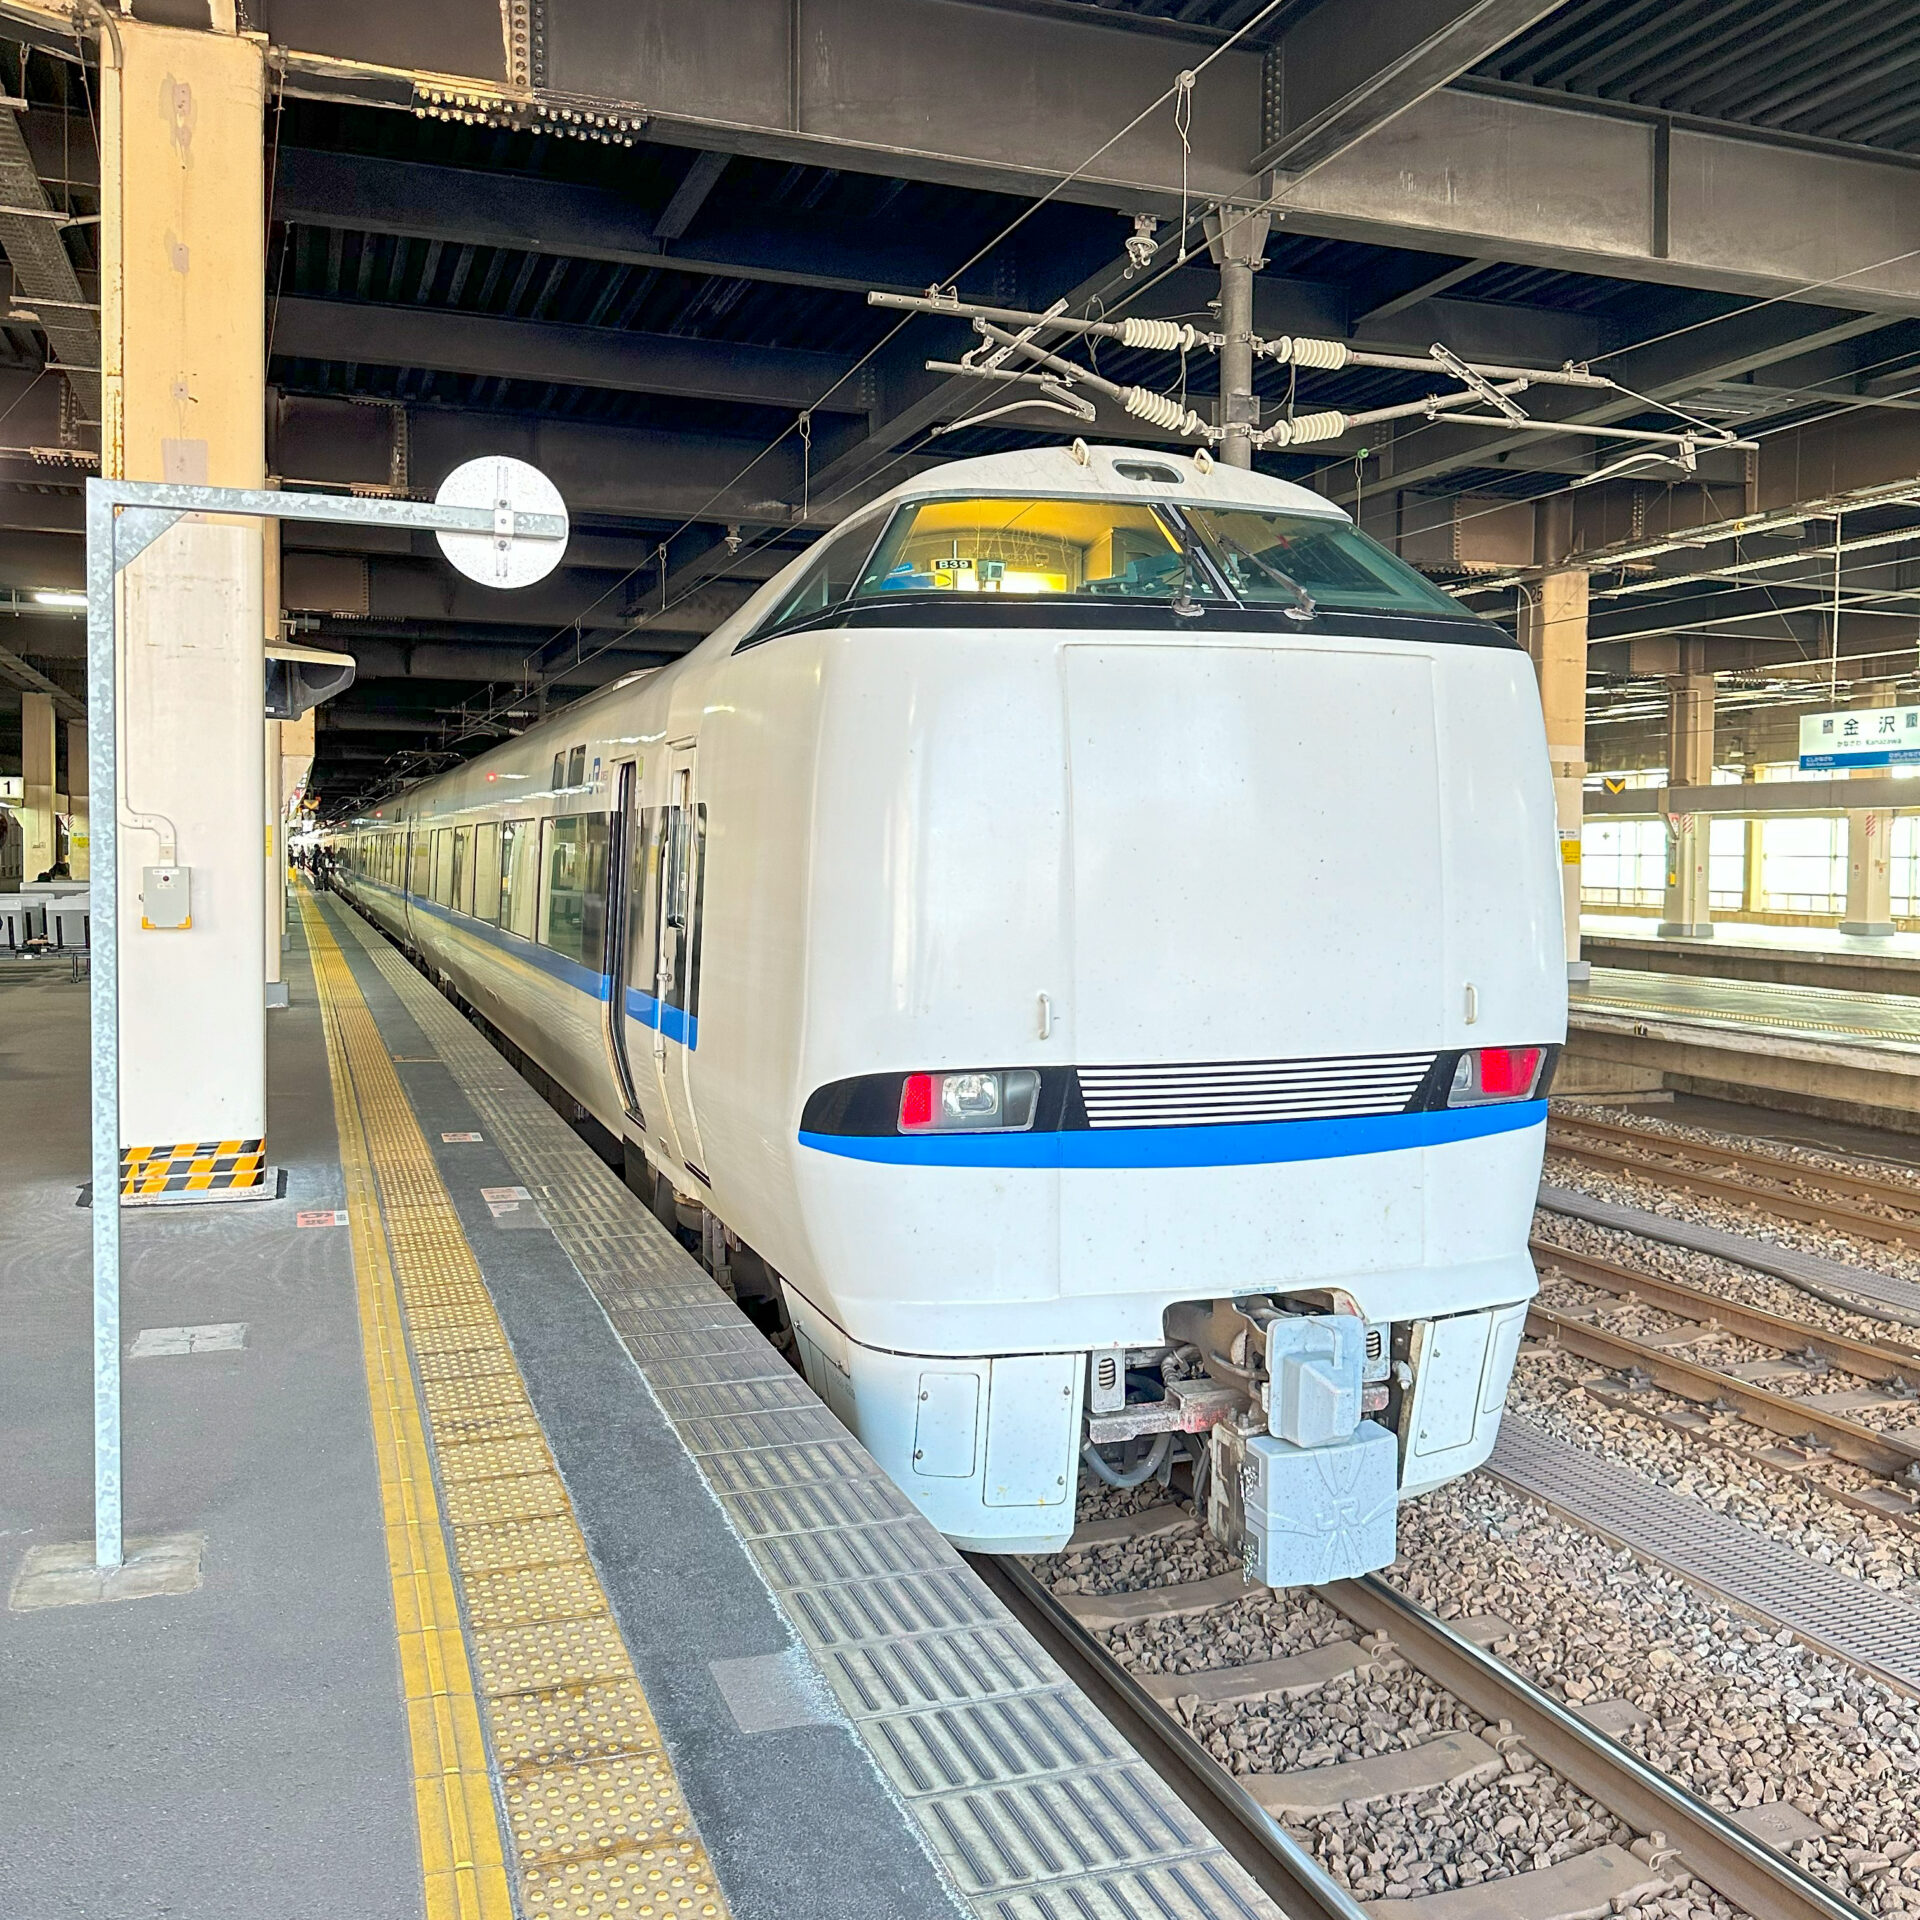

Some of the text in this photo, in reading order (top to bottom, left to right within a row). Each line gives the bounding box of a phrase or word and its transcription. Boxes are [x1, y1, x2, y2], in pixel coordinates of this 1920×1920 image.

[938, 560, 969, 570] B39
[1530, 585, 1544, 603] 25
[1843, 715, 1895, 736] 金沢
[3, 780, 10, 794] 1
[1316, 1498, 1360, 1532] JR
